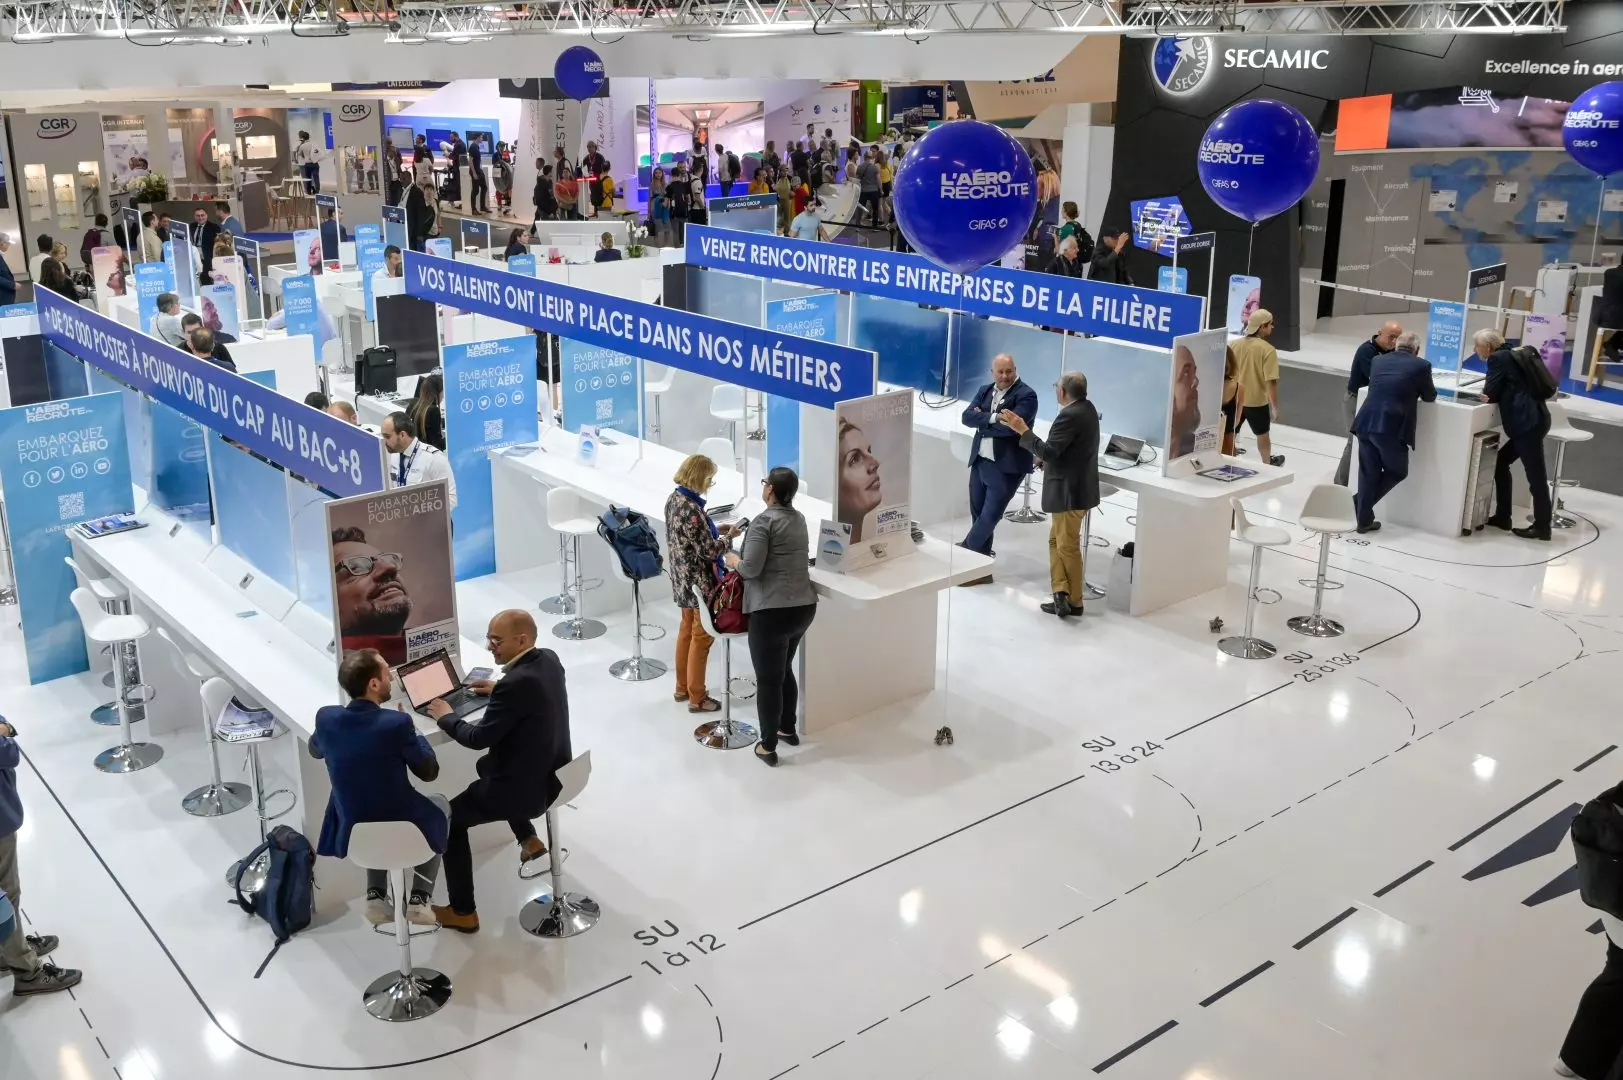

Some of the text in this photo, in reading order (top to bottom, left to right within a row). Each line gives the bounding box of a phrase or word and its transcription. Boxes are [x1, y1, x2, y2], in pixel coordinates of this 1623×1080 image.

[1175, 38, 1207, 90] SECAMIC
[1224, 48, 1329, 70] SECAMIC
[1485, 60, 1570, 74] Excellence
[1573, 60, 1590, 75] in
[342, 104, 366, 114] CGR
[40, 118, 70, 129] CGR
[1202, 138, 1244, 153] L'AÉRO
[1200, 151, 1264, 164] RECRUTE
[941, 169, 1011, 185] L'AÉRO
[1212, 178, 1230, 188] GIFAS
[940, 183, 1029, 199] RECRUTE
[969, 219, 996, 230] GIFAS
[700, 236, 1172, 333] VENEZ RENCONTRER LES ENTREPRISES DE LA FILIÈRE
[418, 265, 842, 393] VOS TALENTS ONT LEUR PLACE DANS NOS MÉTIERS
[776, 318, 824, 332] EMBARQUEZ
[459, 364, 520, 382] EMBARQUEZ
[574, 361, 599, 373] POUR
[460, 379, 487, 392] POUR
[44, 306, 362, 486] + DE 25 000 POSTES À POURVOIR DU CAP AU BAC+8
[17, 426, 104, 452] EMBARQUEZ
[19, 447, 58, 464] POUR
[367, 488, 439, 512] EMBARQUEZ
[368, 508, 400, 524] POUR
[1284, 651, 1313, 664] SU
[1294, 669, 1322, 682] 25
[1326, 652, 1360, 667] 136
[1082, 735, 1116, 753] SU
[1090, 740, 1164, 774] 13 à 24
[633, 920, 679, 946] SU
[641, 934, 726, 975] 1 à 12
